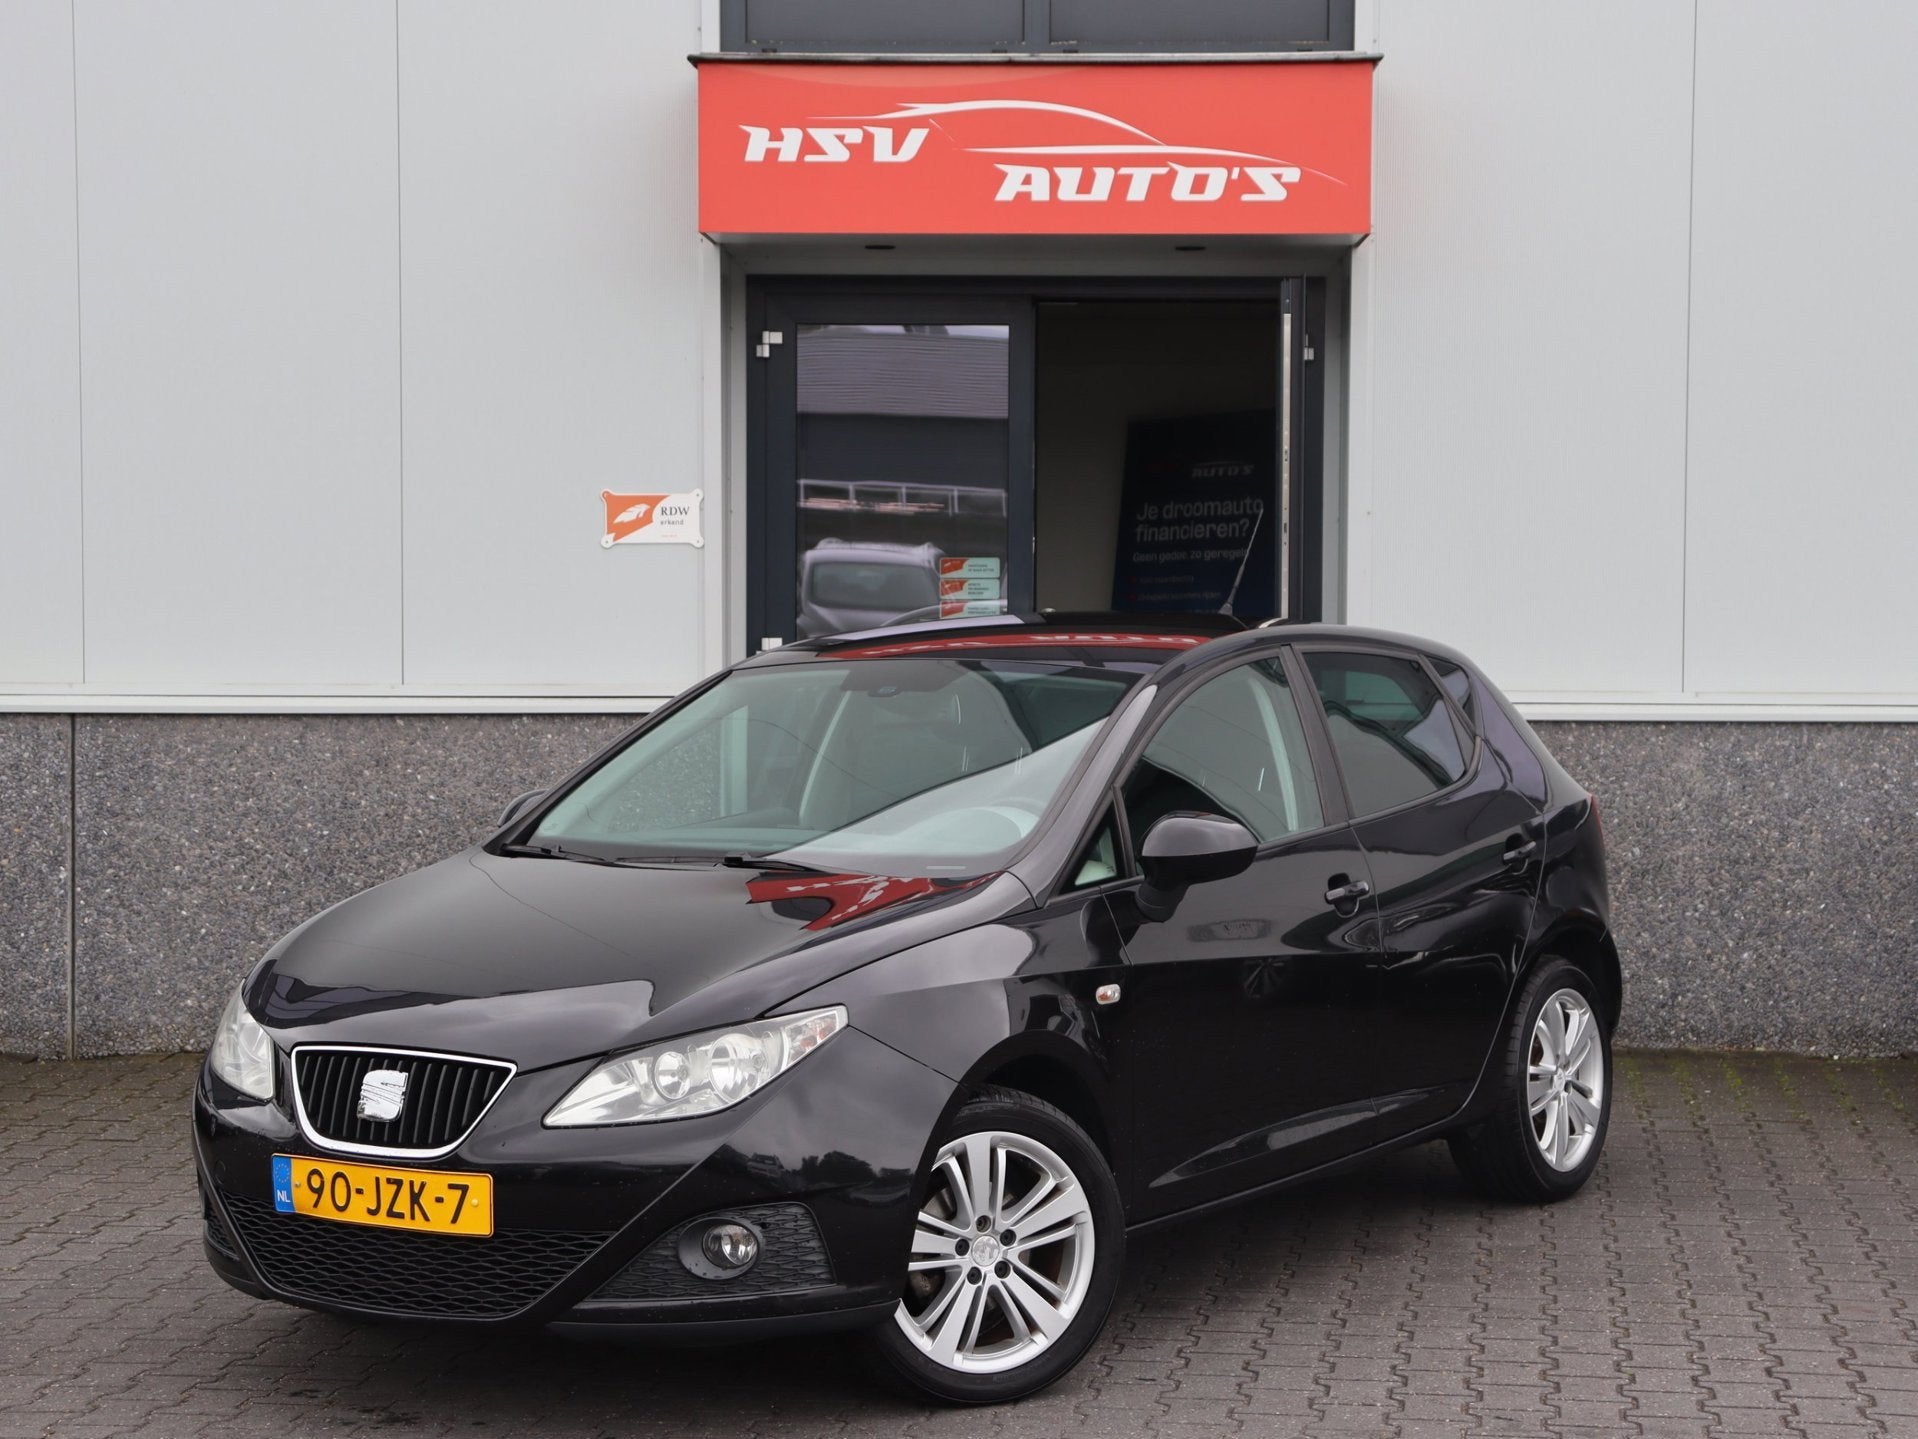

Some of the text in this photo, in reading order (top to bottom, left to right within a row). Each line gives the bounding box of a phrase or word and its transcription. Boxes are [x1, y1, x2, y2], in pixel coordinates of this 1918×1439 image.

[739, 124, 930, 162] HSV
[994, 160, 1301, 201] AUTO'S
[661, 506, 690, 516] RDW
[1136, 497, 1264, 520] Je droomauto
[1135, 519, 1250, 543] financieren?
[1190, 551, 1202, 559] zo
[277, 1189, 291, 1203] NL
[306, 1168, 470, 1224] 90-JZK-7
